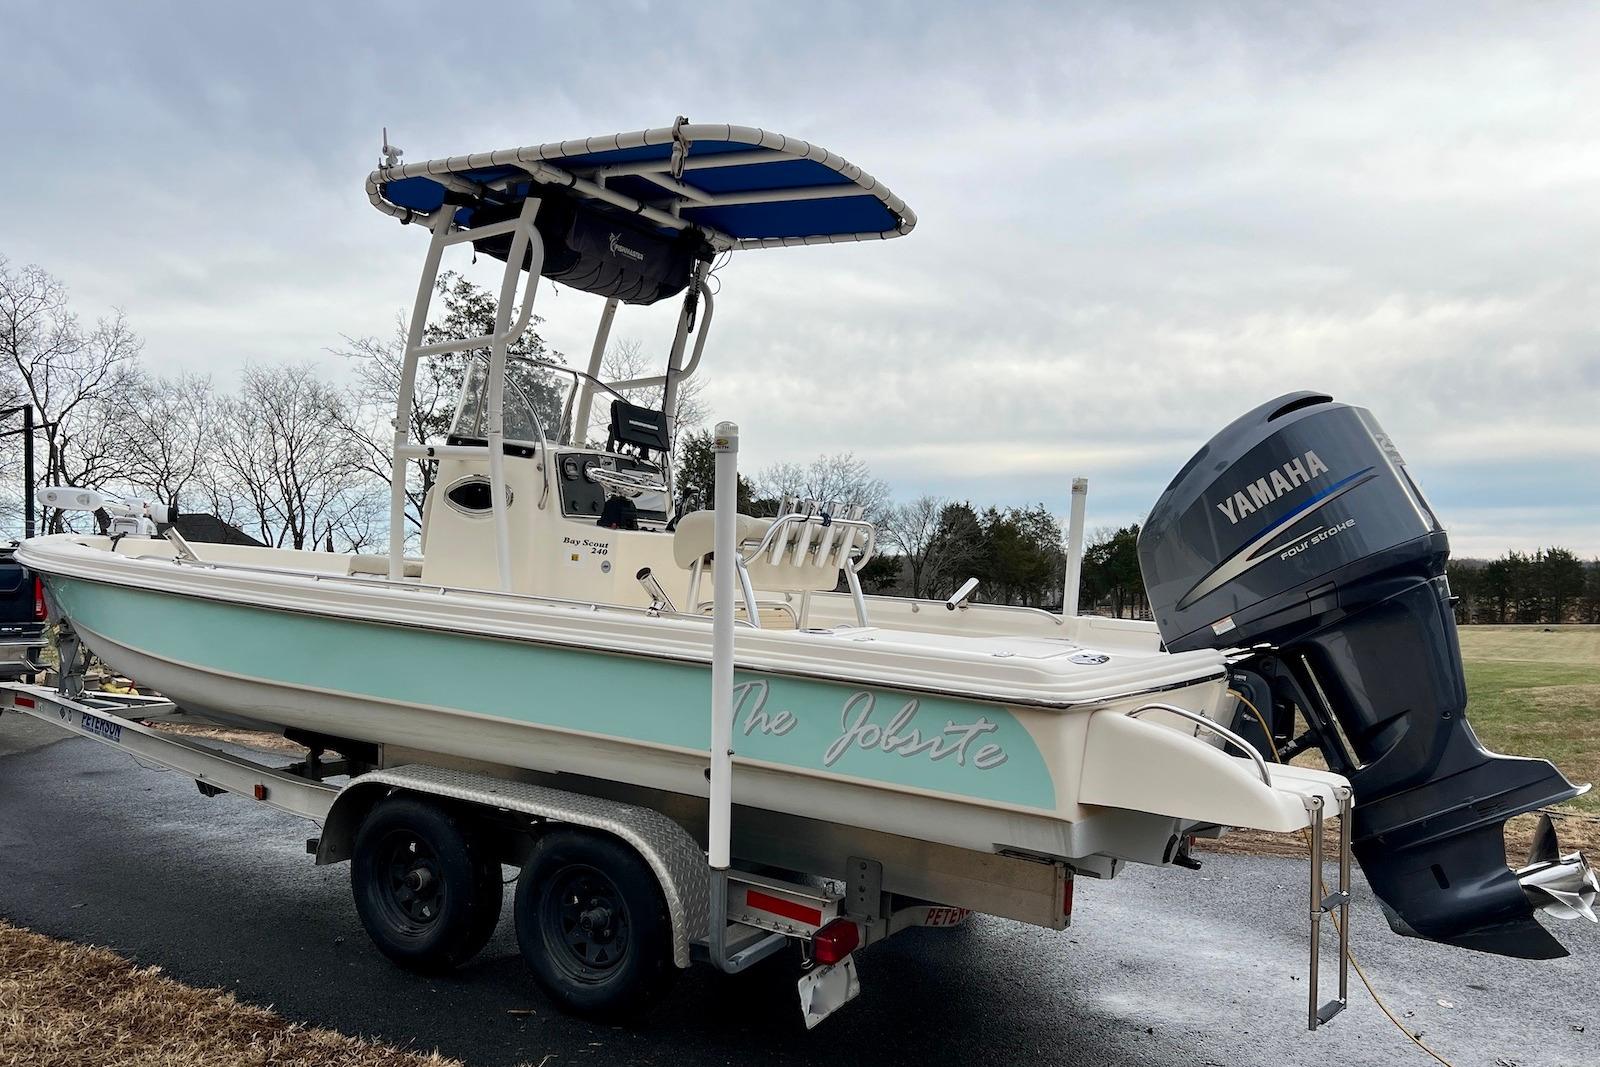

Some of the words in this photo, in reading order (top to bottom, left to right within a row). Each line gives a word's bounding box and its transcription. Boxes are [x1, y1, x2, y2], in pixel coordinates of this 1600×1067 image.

[1217, 449, 1329, 525] YAMAHA
[563, 536, 581, 546] Bay
[582, 539, 609, 548] Scout
[591, 547, 608, 555] 240
[81, 713, 122, 738] PETERSON
[731, 679, 798, 737] The
[823, 690, 1010, 771] Jobsite
